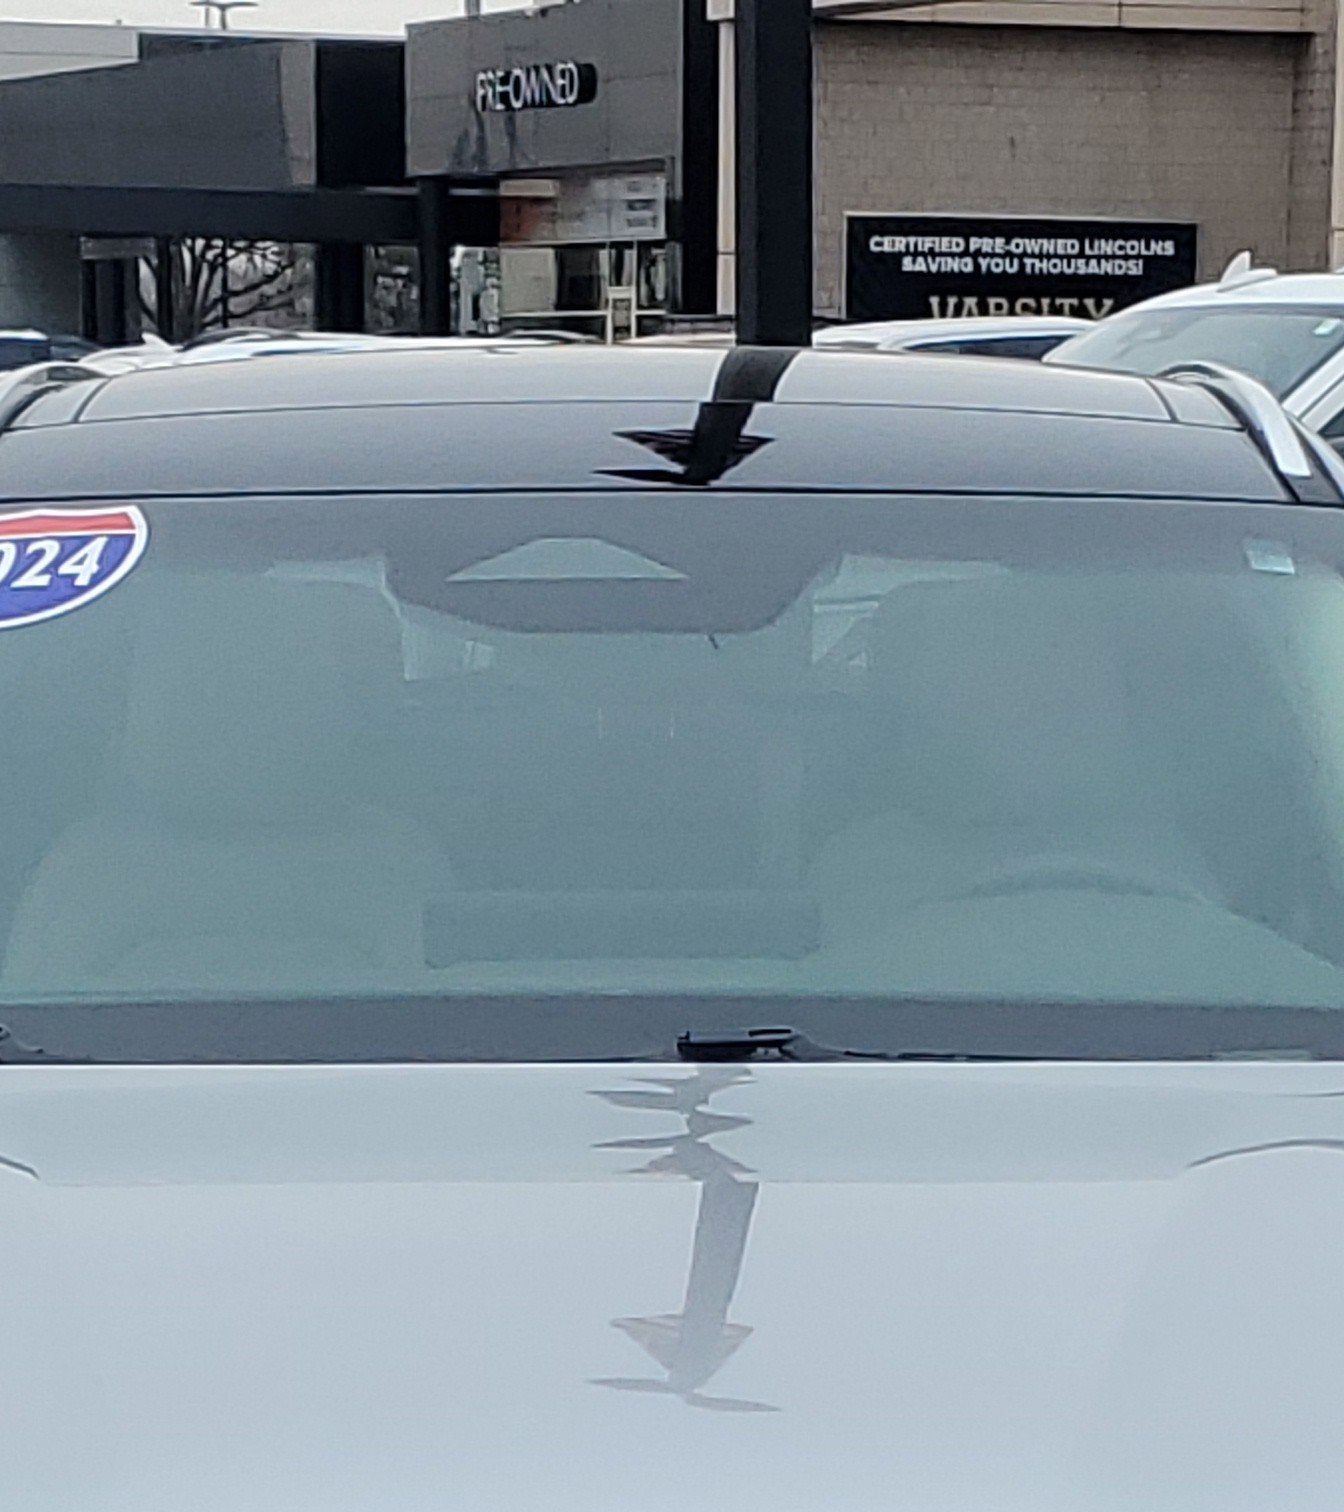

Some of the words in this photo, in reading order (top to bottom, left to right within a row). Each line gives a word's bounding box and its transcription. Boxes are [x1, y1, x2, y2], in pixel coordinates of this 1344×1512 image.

[869, 235, 966, 253] CERTIFIED
[969, 236, 1080, 256] PRE-OWNED
[1084, 238, 1176, 256] LINCOLNS
[902, 255, 974, 274] SAVING
[977, 256, 1020, 275] YOU
[1023, 257, 1144, 276] THOUSANDS!
